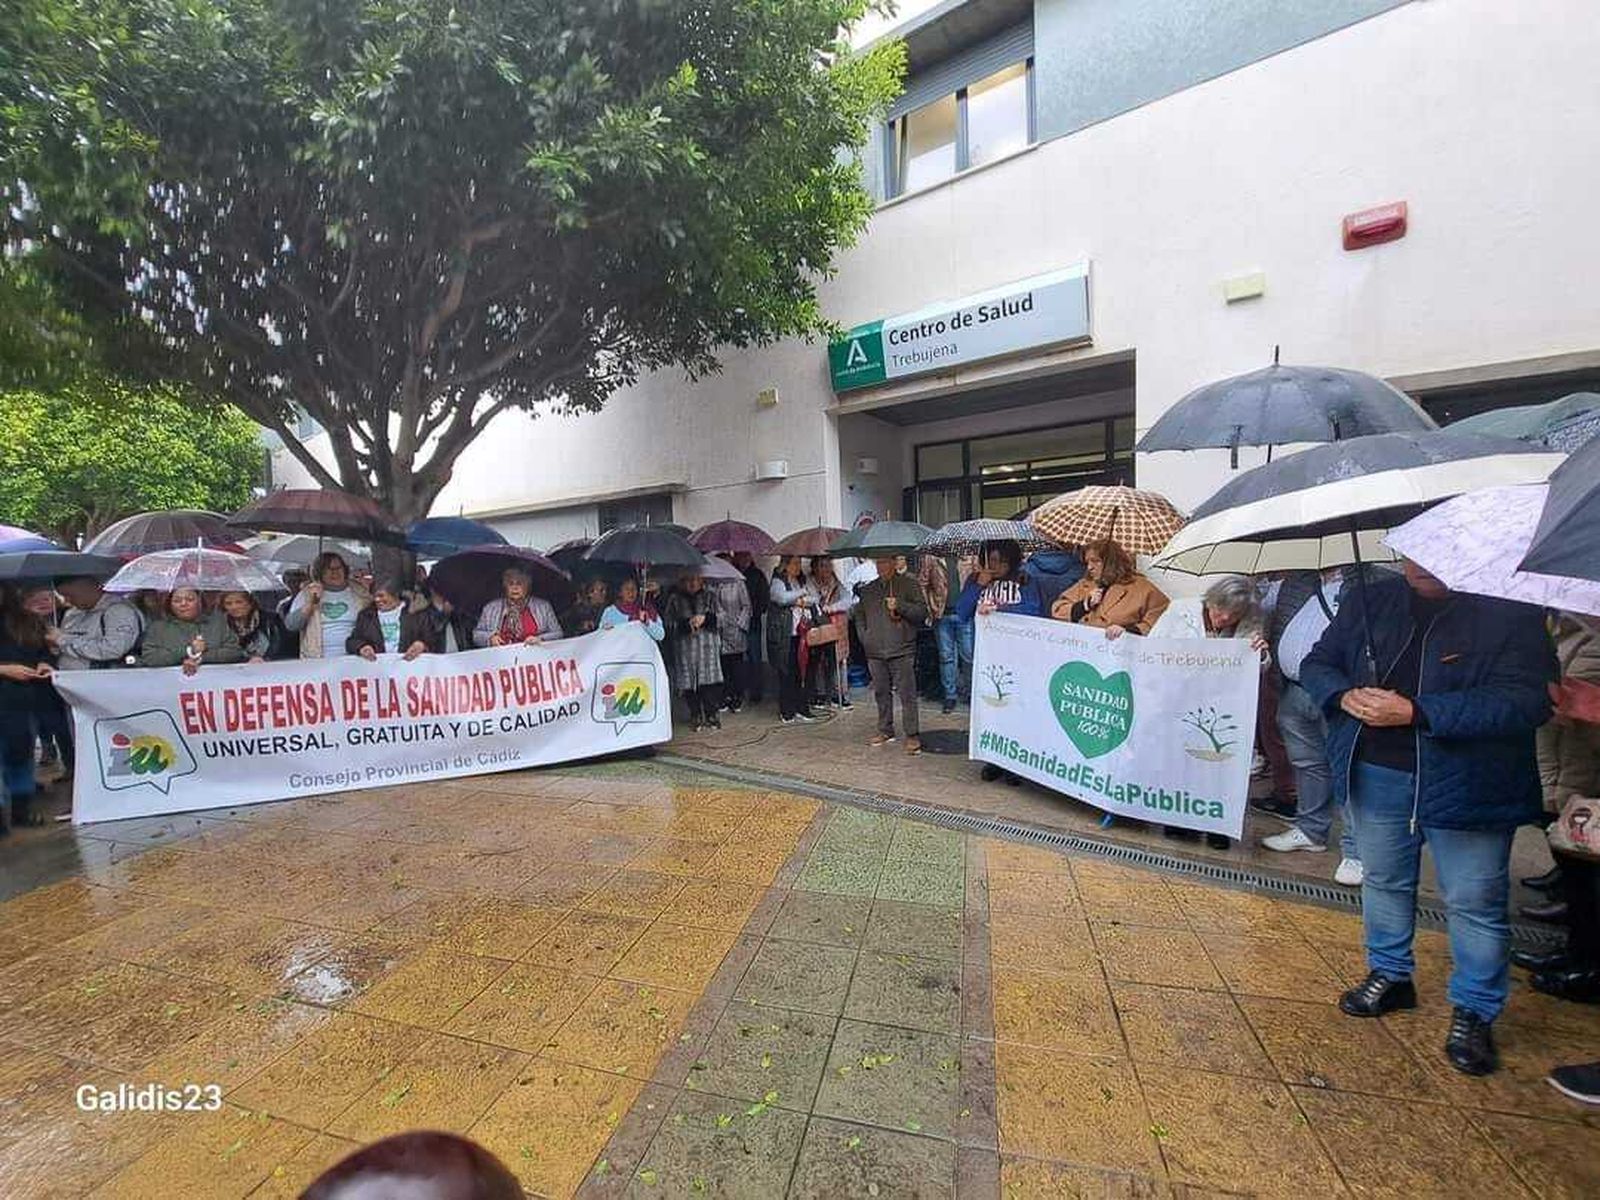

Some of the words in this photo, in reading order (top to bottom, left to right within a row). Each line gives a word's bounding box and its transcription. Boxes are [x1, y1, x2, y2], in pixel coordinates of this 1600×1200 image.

[889, 321, 946, 345] Centro
[950, 311, 973, 330] de
[978, 292, 1033, 323] Salud
[892, 343, 959, 368] Trebujena
[1156, 651, 1243, 668] Trebujena
[179, 691, 217, 735] EN
[223, 682, 336, 732] DEFENSA
[340, 678, 370, 721] DE
[374, 677, 401, 719] LA
[406, 671, 496, 717] SANIDAD
[500, 657, 585, 709] PÚBLICA
[1061, 681, 1129, 710] SANIDAD
[202, 731, 340, 758] UNIVERSAL,
[346, 722, 445, 746] GRATUITA
[448, 722, 462, 738] Y
[467, 719, 494, 738] DE
[499, 701, 581, 733] CALIDAD
[289, 768, 361, 789] Consejo
[365, 759, 448, 782] Provincial
[453, 755, 472, 769] de
[979, 730, 1224, 819] #MiSanidadEsLaPública
